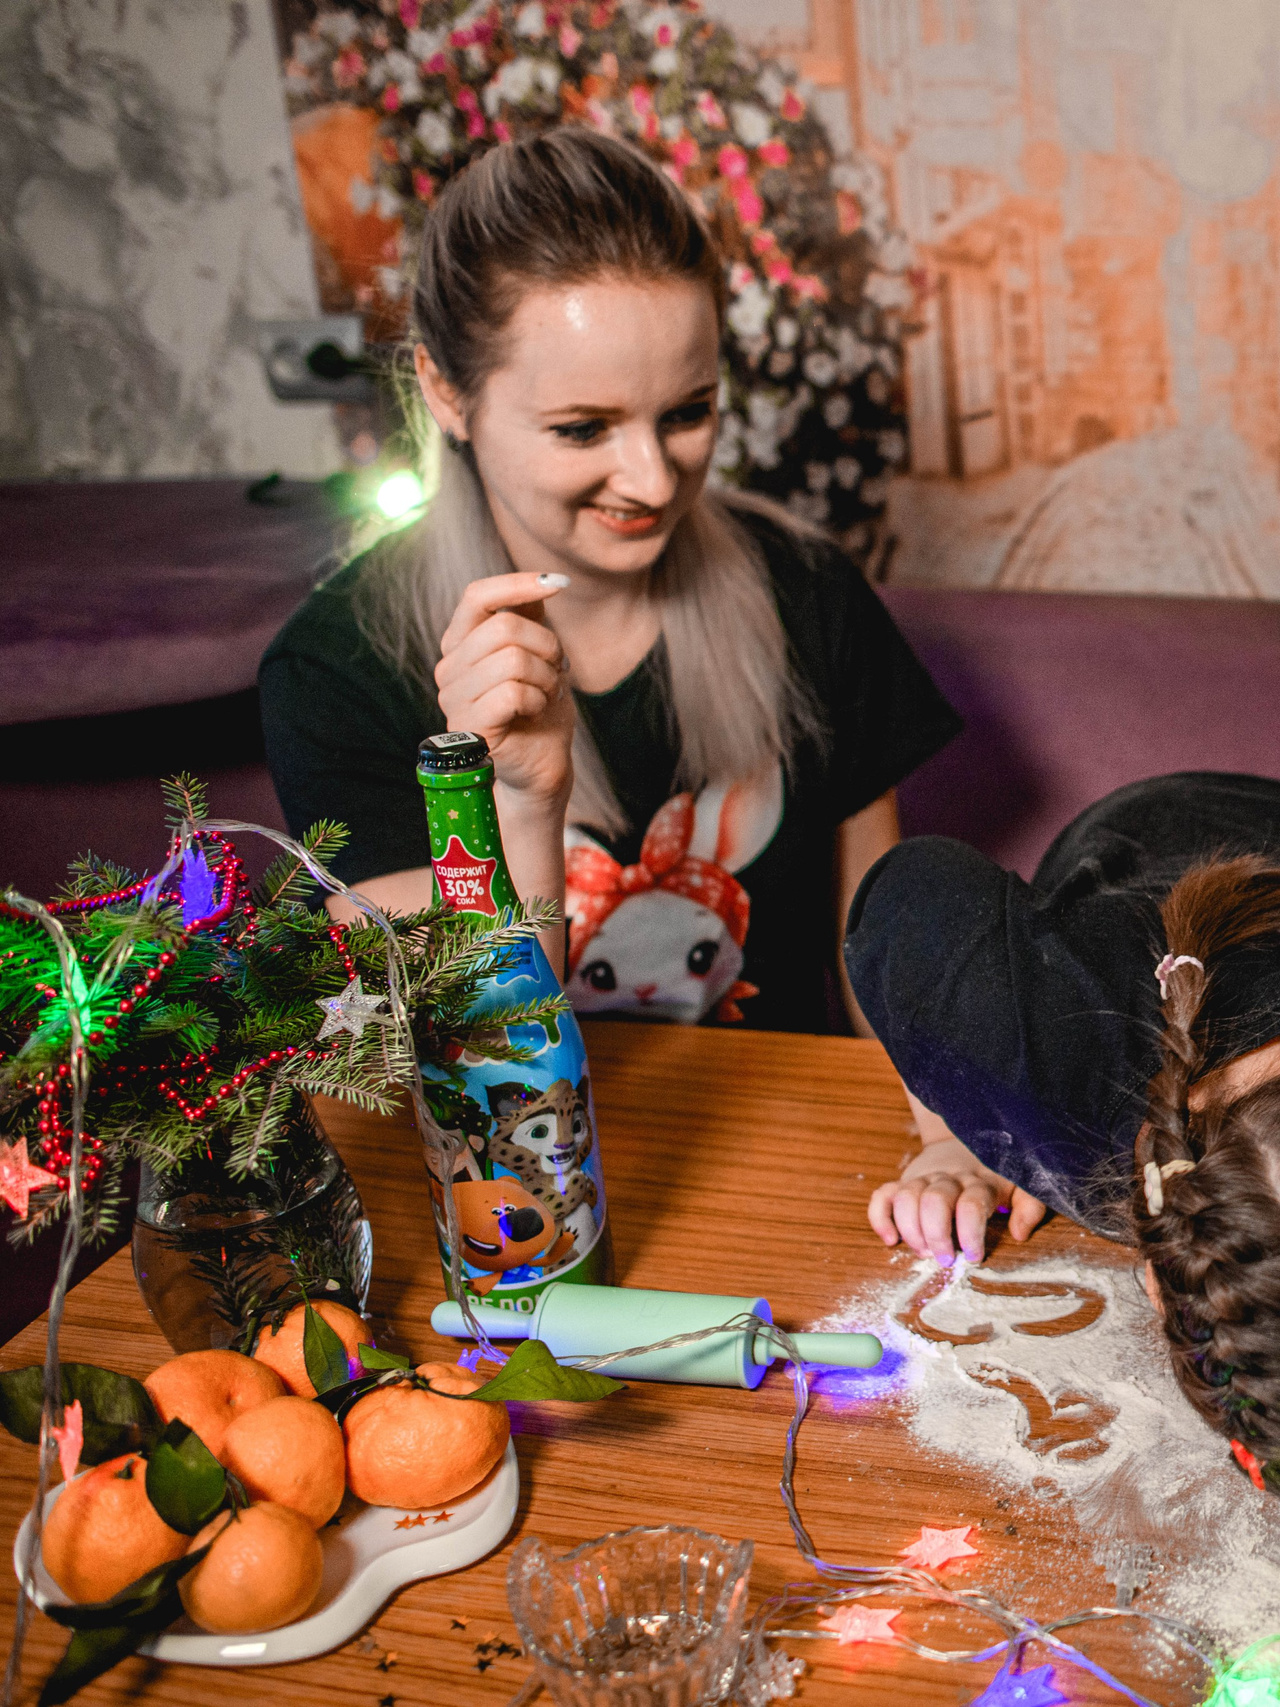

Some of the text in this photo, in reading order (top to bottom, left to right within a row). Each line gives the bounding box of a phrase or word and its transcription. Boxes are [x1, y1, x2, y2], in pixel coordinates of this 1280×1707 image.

[436, 864, 487, 879] СОДЕРЖИТ
[444, 878, 485, 897] 30%
[456, 897, 476, 905] СОКА
